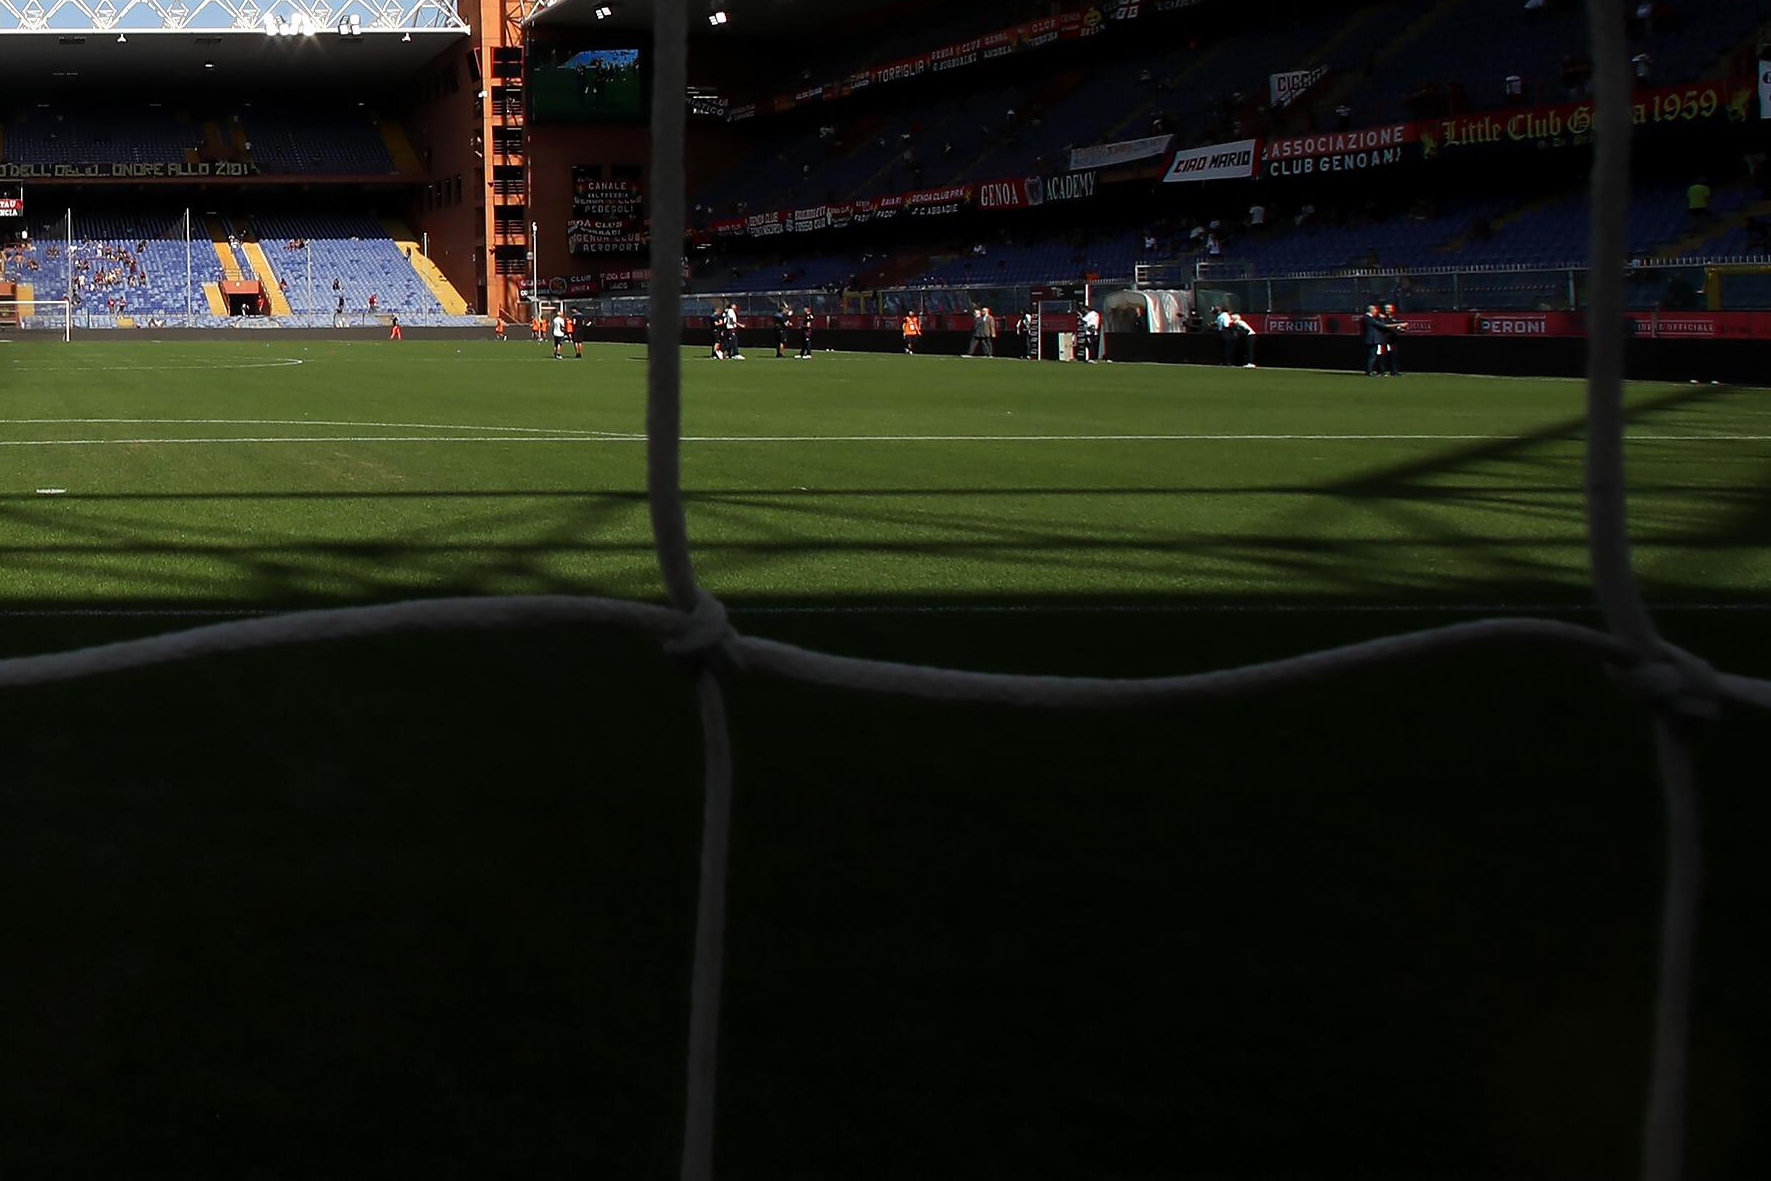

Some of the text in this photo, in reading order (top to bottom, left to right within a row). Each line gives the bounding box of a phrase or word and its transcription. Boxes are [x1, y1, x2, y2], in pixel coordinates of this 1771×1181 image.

[877, 60, 925, 83] TORRIGLIA
[1442, 115, 1501, 147] Little
[1507, 109, 1563, 141] Club
[1651, 88, 1718, 123] 1959
[1271, 126, 1405, 158] ASSOCIAZIONE
[112, 163, 165, 177] ONORE
[167, 163, 210, 176] ALLO
[1173, 150, 1251, 173] CIAO MARIO
[1270, 158, 1314, 177] CLUB
[588, 182, 627, 190] CANALE
[981, 171, 1096, 206] GENOA ACADEMY
[583, 243, 643, 251] AEROPORT
[1269, 321, 1317, 332] PERONI
[1481, 321, 1545, 333] PERONI
